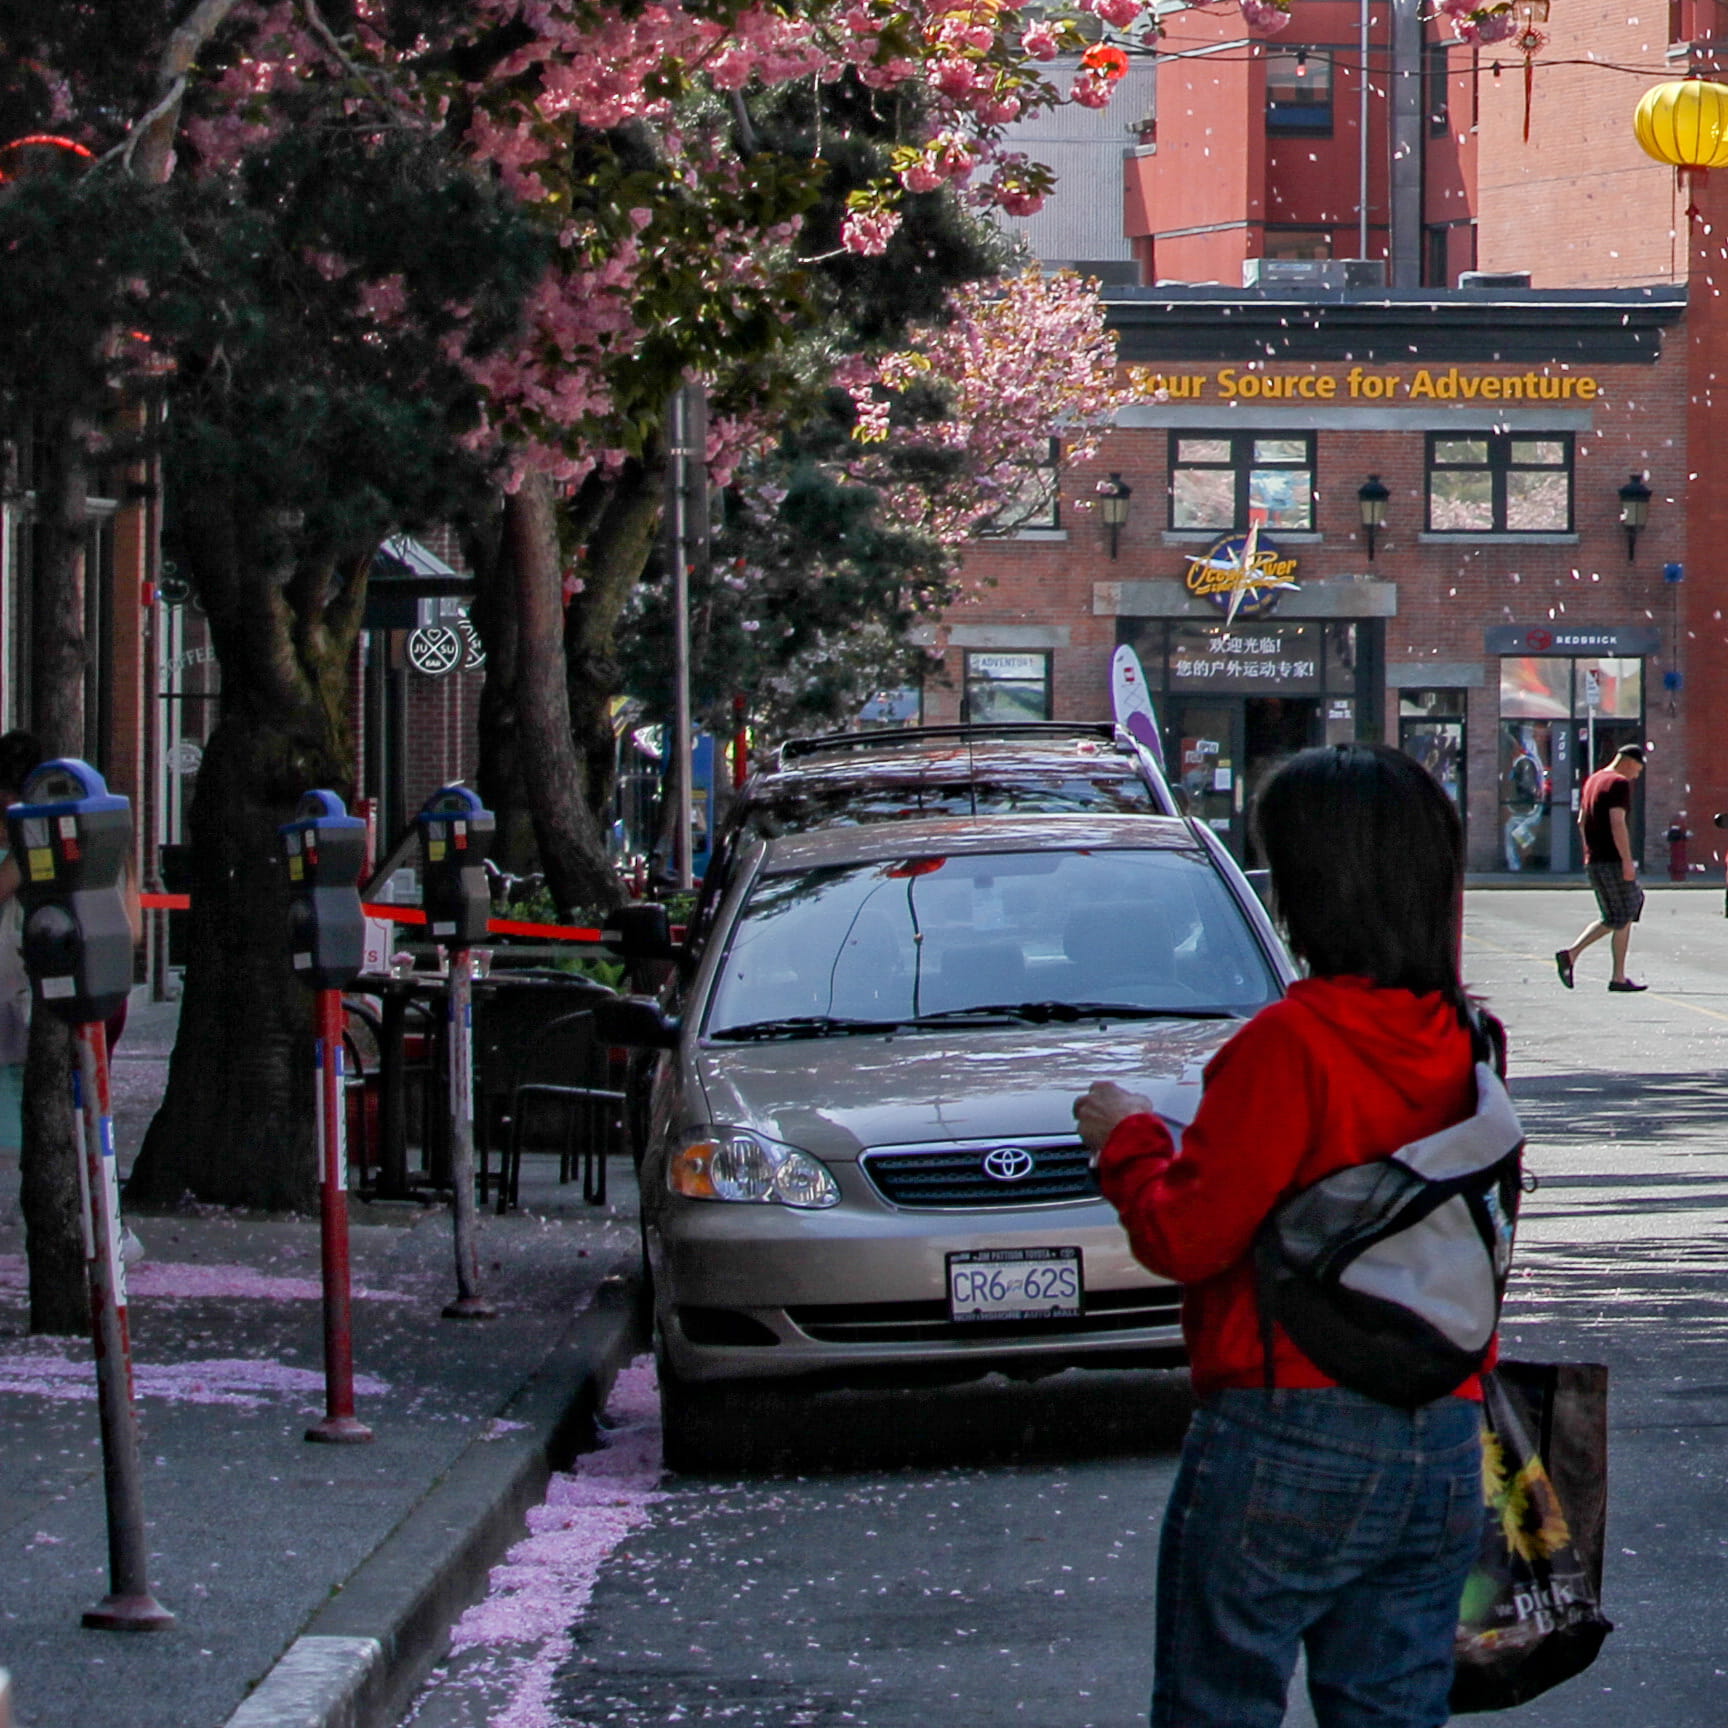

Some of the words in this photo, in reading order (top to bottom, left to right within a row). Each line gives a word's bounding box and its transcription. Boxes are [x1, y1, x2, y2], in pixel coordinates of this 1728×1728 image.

[1217, 368, 1336, 399] Source
[1346, 368, 1400, 398] for
[1409, 368, 1597, 399] Adventure
[1556, 636, 1618, 645] REDBRICK
[953, 1270, 1007, 1302] CR6
[1023, 1267, 1076, 1299] 62S
